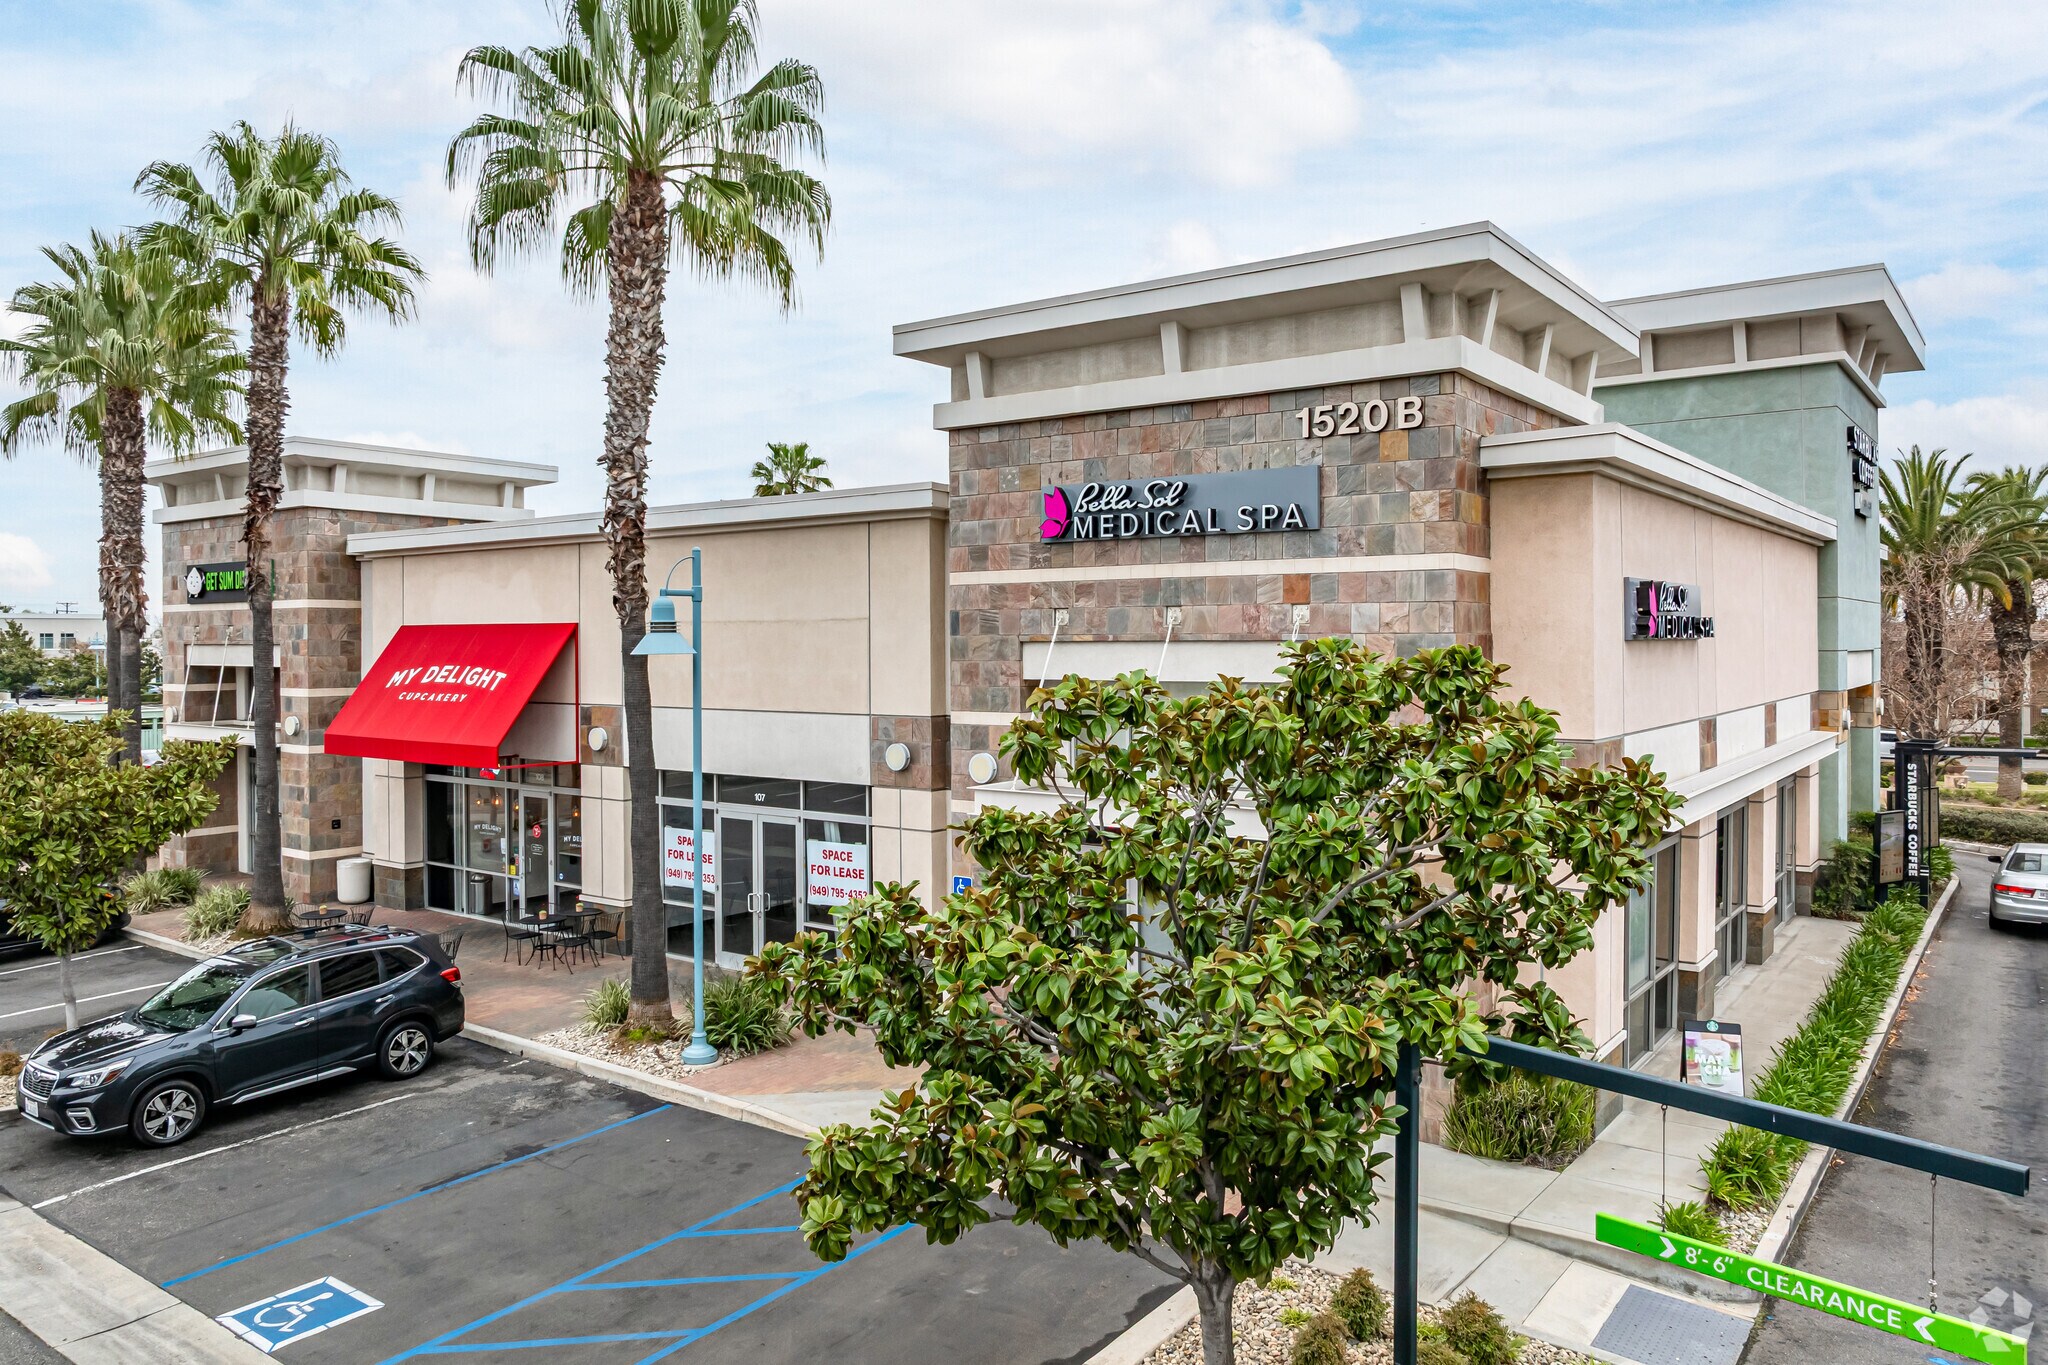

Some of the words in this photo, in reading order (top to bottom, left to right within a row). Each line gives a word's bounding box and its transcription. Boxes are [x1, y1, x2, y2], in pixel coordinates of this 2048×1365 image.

[1296, 400, 1388, 439] 1520
[1397, 396, 1424, 430] B
[1074, 482, 1137, 513] Bella
[1137, 480, 1180, 509] Sol
[1073, 508, 1221, 539] MEDICAL
[1237, 503, 1305, 532] SPA
[205, 570, 218, 592] GET
[219, 570, 233, 591] SUM
[1657, 615, 1698, 639] MEDICAL
[1700, 616, 1715, 639] SPA
[385, 667, 423, 688] MY
[421, 665, 508, 691] DELIGHT
[398, 692, 468, 703] CUPCAKERY
[754, 793, 766, 802] 107
[1907, 763, 1918, 830] STARBUCKS
[667, 849, 684, 860] FOR
[686, 852, 713, 865] LESE
[822, 849, 853, 862] SPACE
[1907, 834, 1918, 877] COFFEE
[666, 867, 682, 880] (949)
[810, 864, 830, 876] FOR
[833, 866, 865, 880] LEASE
[809, 884, 829, 897] (949)
[1746, 1266, 1902, 1330] CLEARANCE
